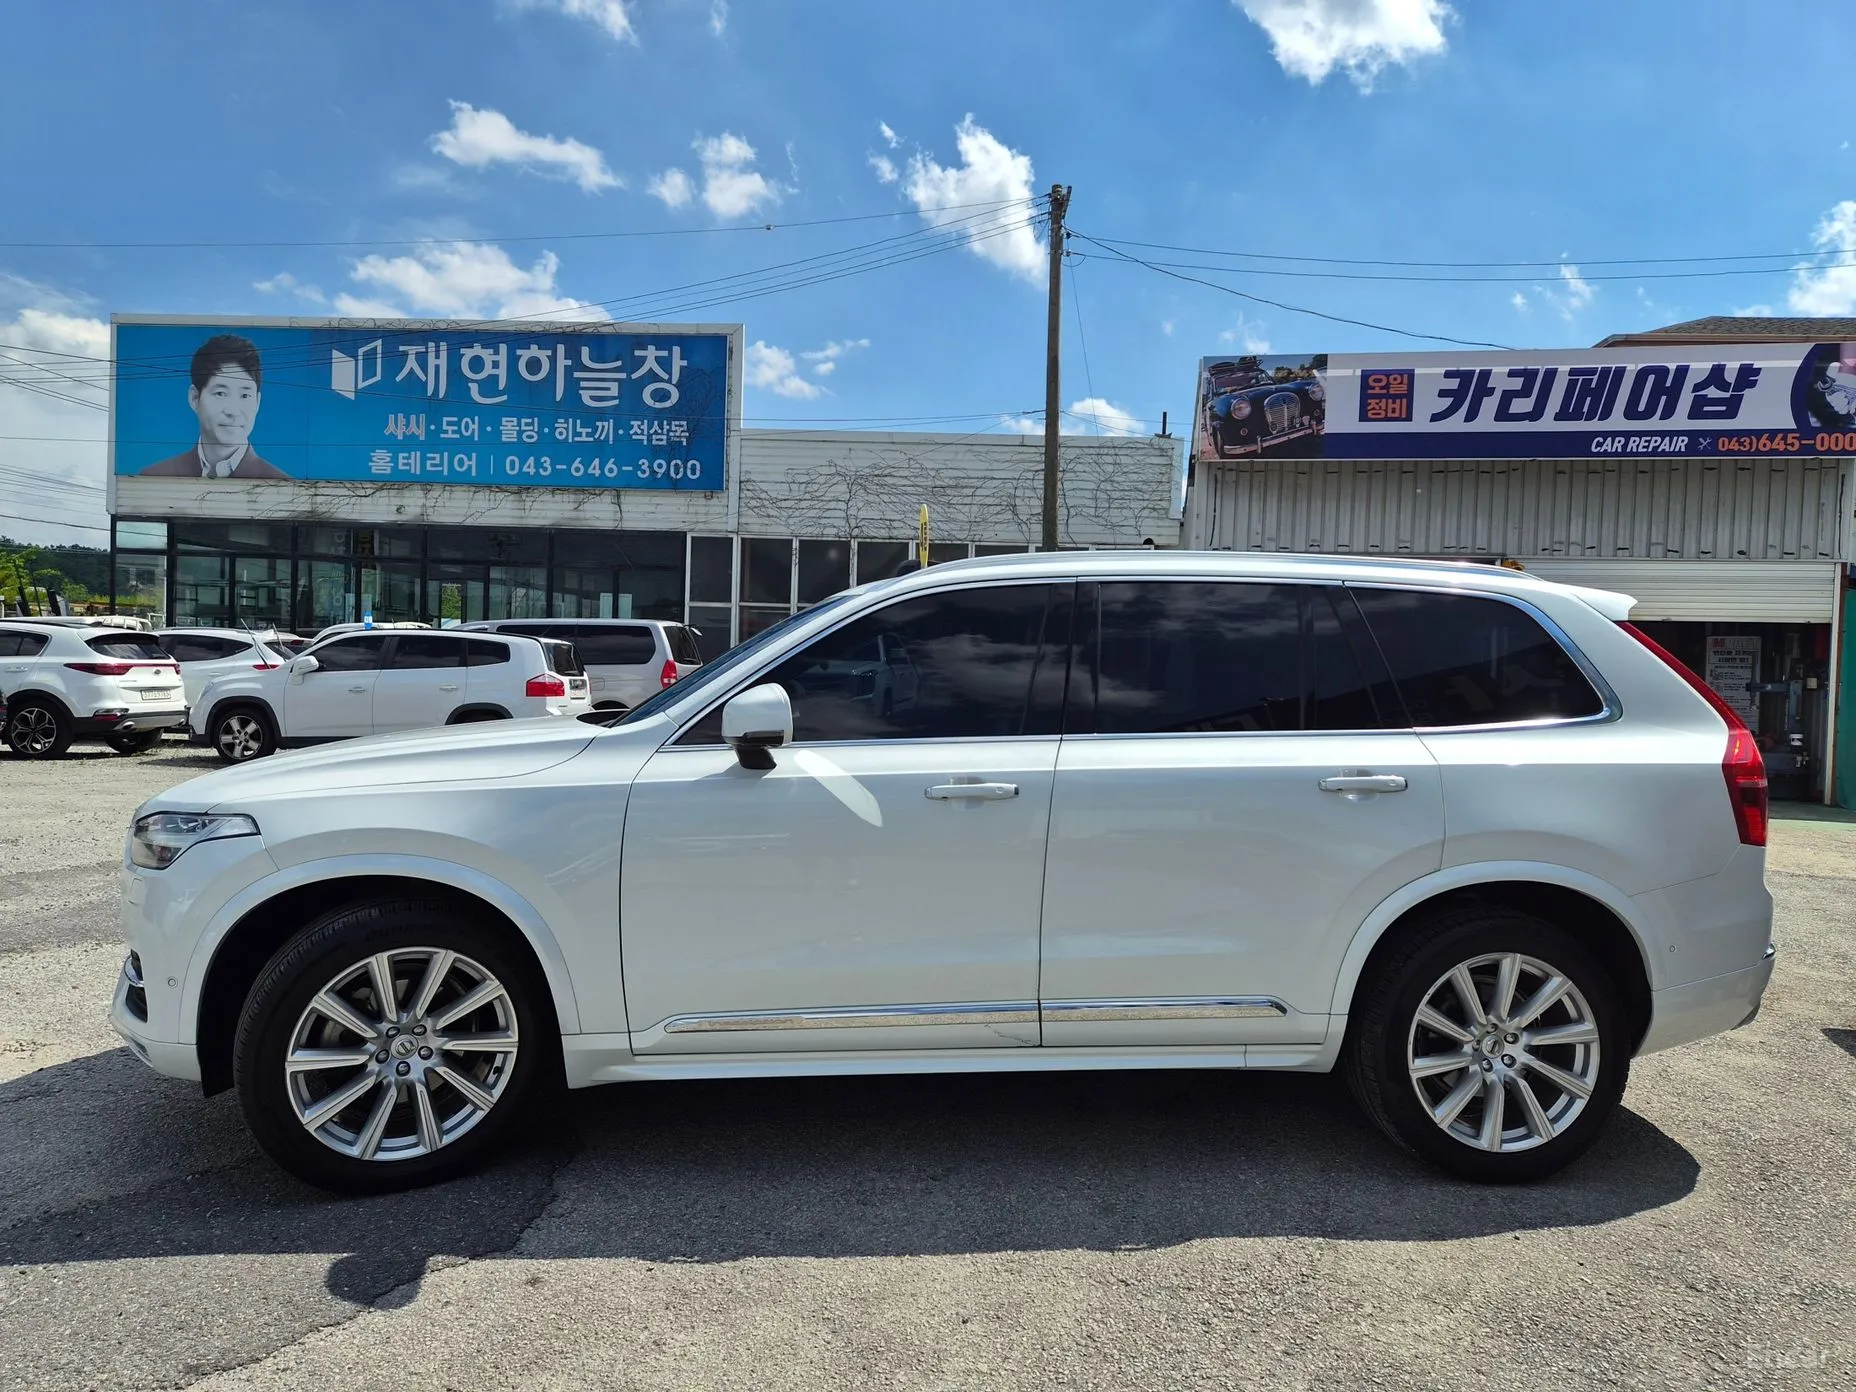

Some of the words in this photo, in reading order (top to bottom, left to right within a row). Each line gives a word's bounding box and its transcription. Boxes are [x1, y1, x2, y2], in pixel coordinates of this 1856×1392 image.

[395, 341, 688, 408] 재현하늘창
[1367, 374, 1408, 394] 오일
[1429, 362, 1762, 423] 카리페어샵
[1367, 398, 1407, 419] 정비
[440, 416, 479, 441] 도어
[500, 417, 538, 443] 몰딩
[554, 418, 614, 445] 히노끼
[1591, 436, 1623, 453] CAR
[1626, 436, 1688, 452] REPAIR
[368, 449, 477, 477] 홈테리어
[505, 455, 701, 480] 043-646-3900
